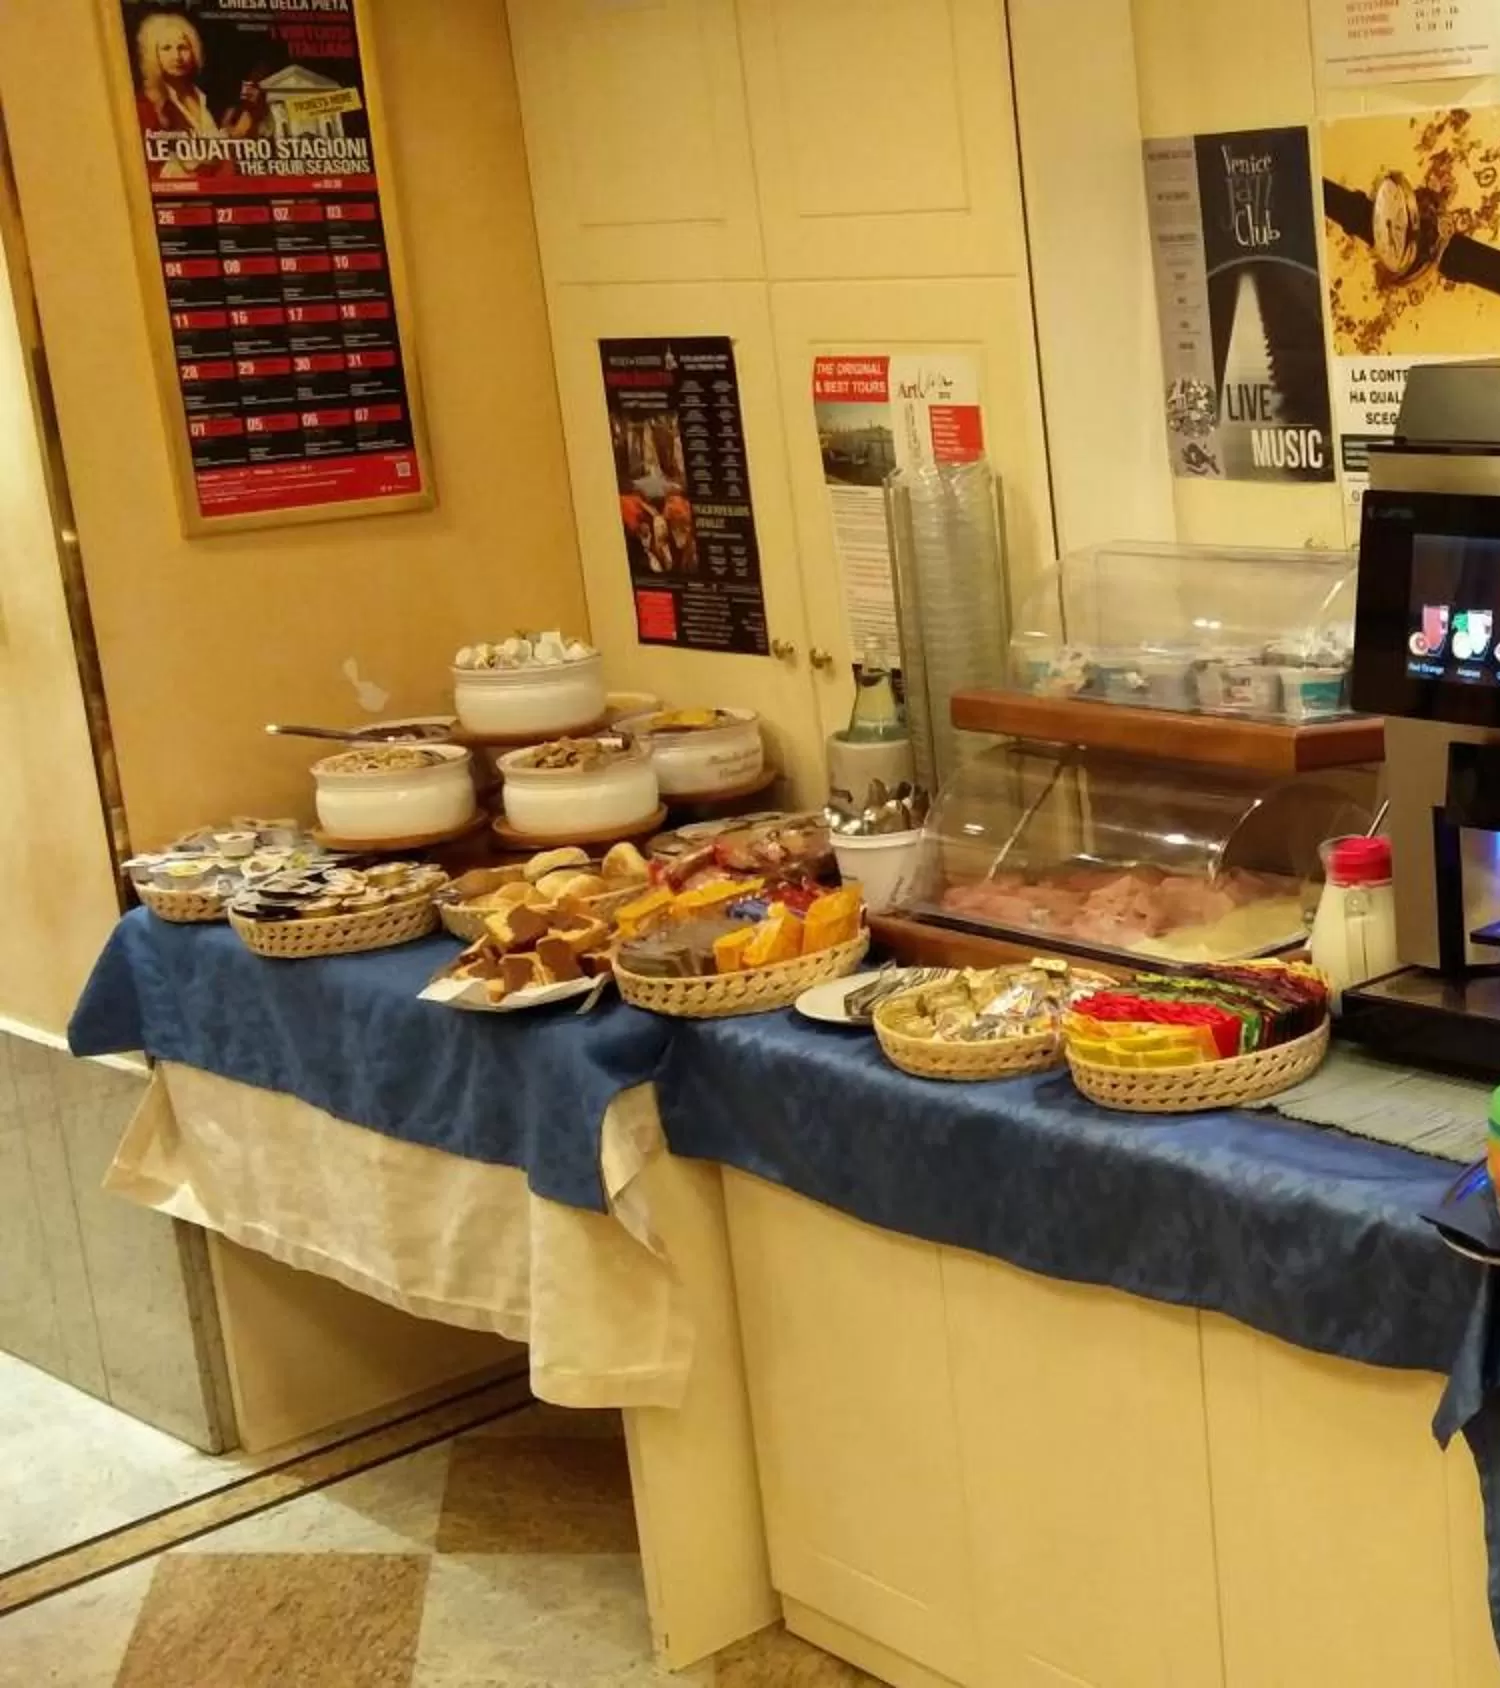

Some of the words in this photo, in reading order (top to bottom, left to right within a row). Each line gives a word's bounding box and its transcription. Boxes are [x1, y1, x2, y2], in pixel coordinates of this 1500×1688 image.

[146, 139, 172, 161] LE
[176, 138, 271, 161] QUATTRO
[277, 137, 368, 160] STAGIONI
[239, 161, 266, 177] THE
[268, 160, 304, 176] FOUR
[305, 159, 371, 175] SEASONS
[1221, 144, 1273, 176] Venice
[1236, 204, 1281, 247] Club
[816, 364, 833, 375] THE
[837, 363, 884, 376] ORIGINAL
[1351, 369, 1367, 383] LA
[824, 381, 849, 392] BEST
[852, 381, 886, 393] TOURS
[1349, 390, 1367, 404] HA
[1226, 383, 1274, 422] LIVE
[1251, 429, 1324, 469] MUSIC
